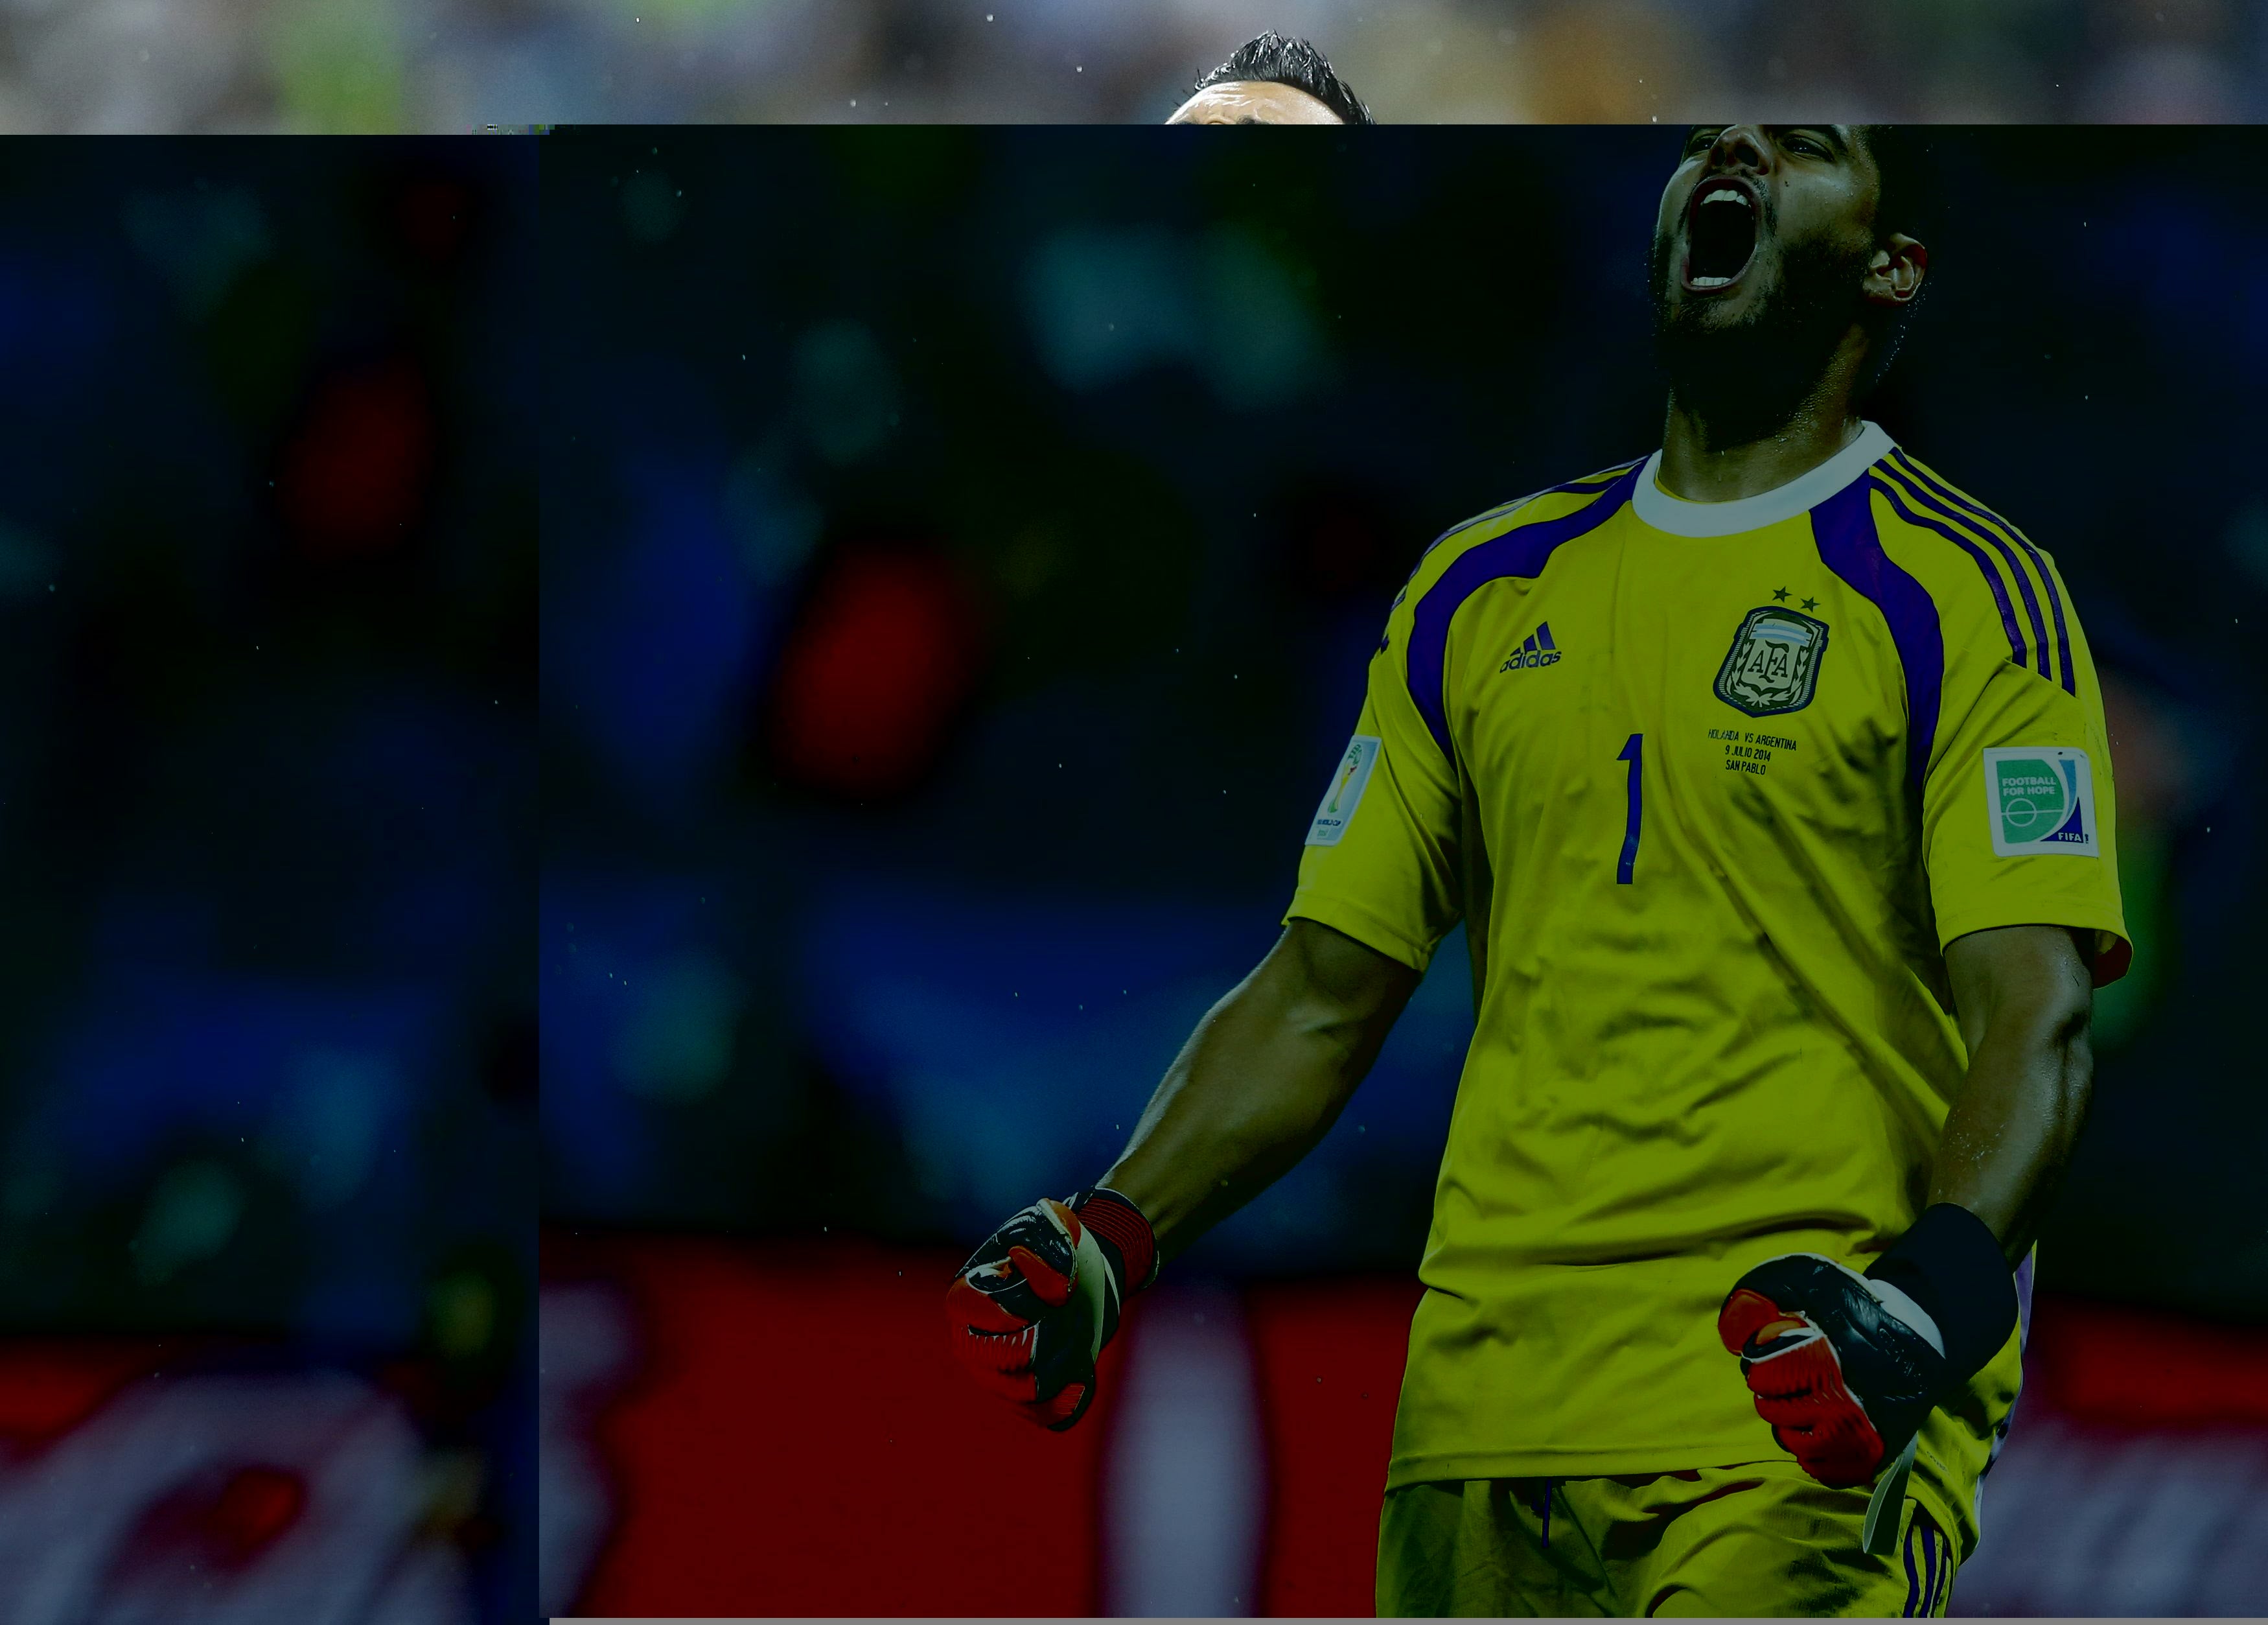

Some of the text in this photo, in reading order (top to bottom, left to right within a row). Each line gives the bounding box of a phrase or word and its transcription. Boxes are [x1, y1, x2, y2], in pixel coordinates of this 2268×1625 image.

[1499, 649, 1562, 673] adidas
[1746, 639, 1789, 683] AFA
[1744, 732, 1754, 743] VS
[1755, 734, 1797, 751] ARGENTINA
[1725, 745, 1772, 762] 9 JULIO 2014
[1726, 759, 1766, 775] SAN PABLO
[2002, 776, 2057, 787] FOOTBALL
[2003, 785, 2055, 797] FOR HOPE
[1616, 733, 1644, 885] 1
[2057, 832, 2082, 842] FIFA
